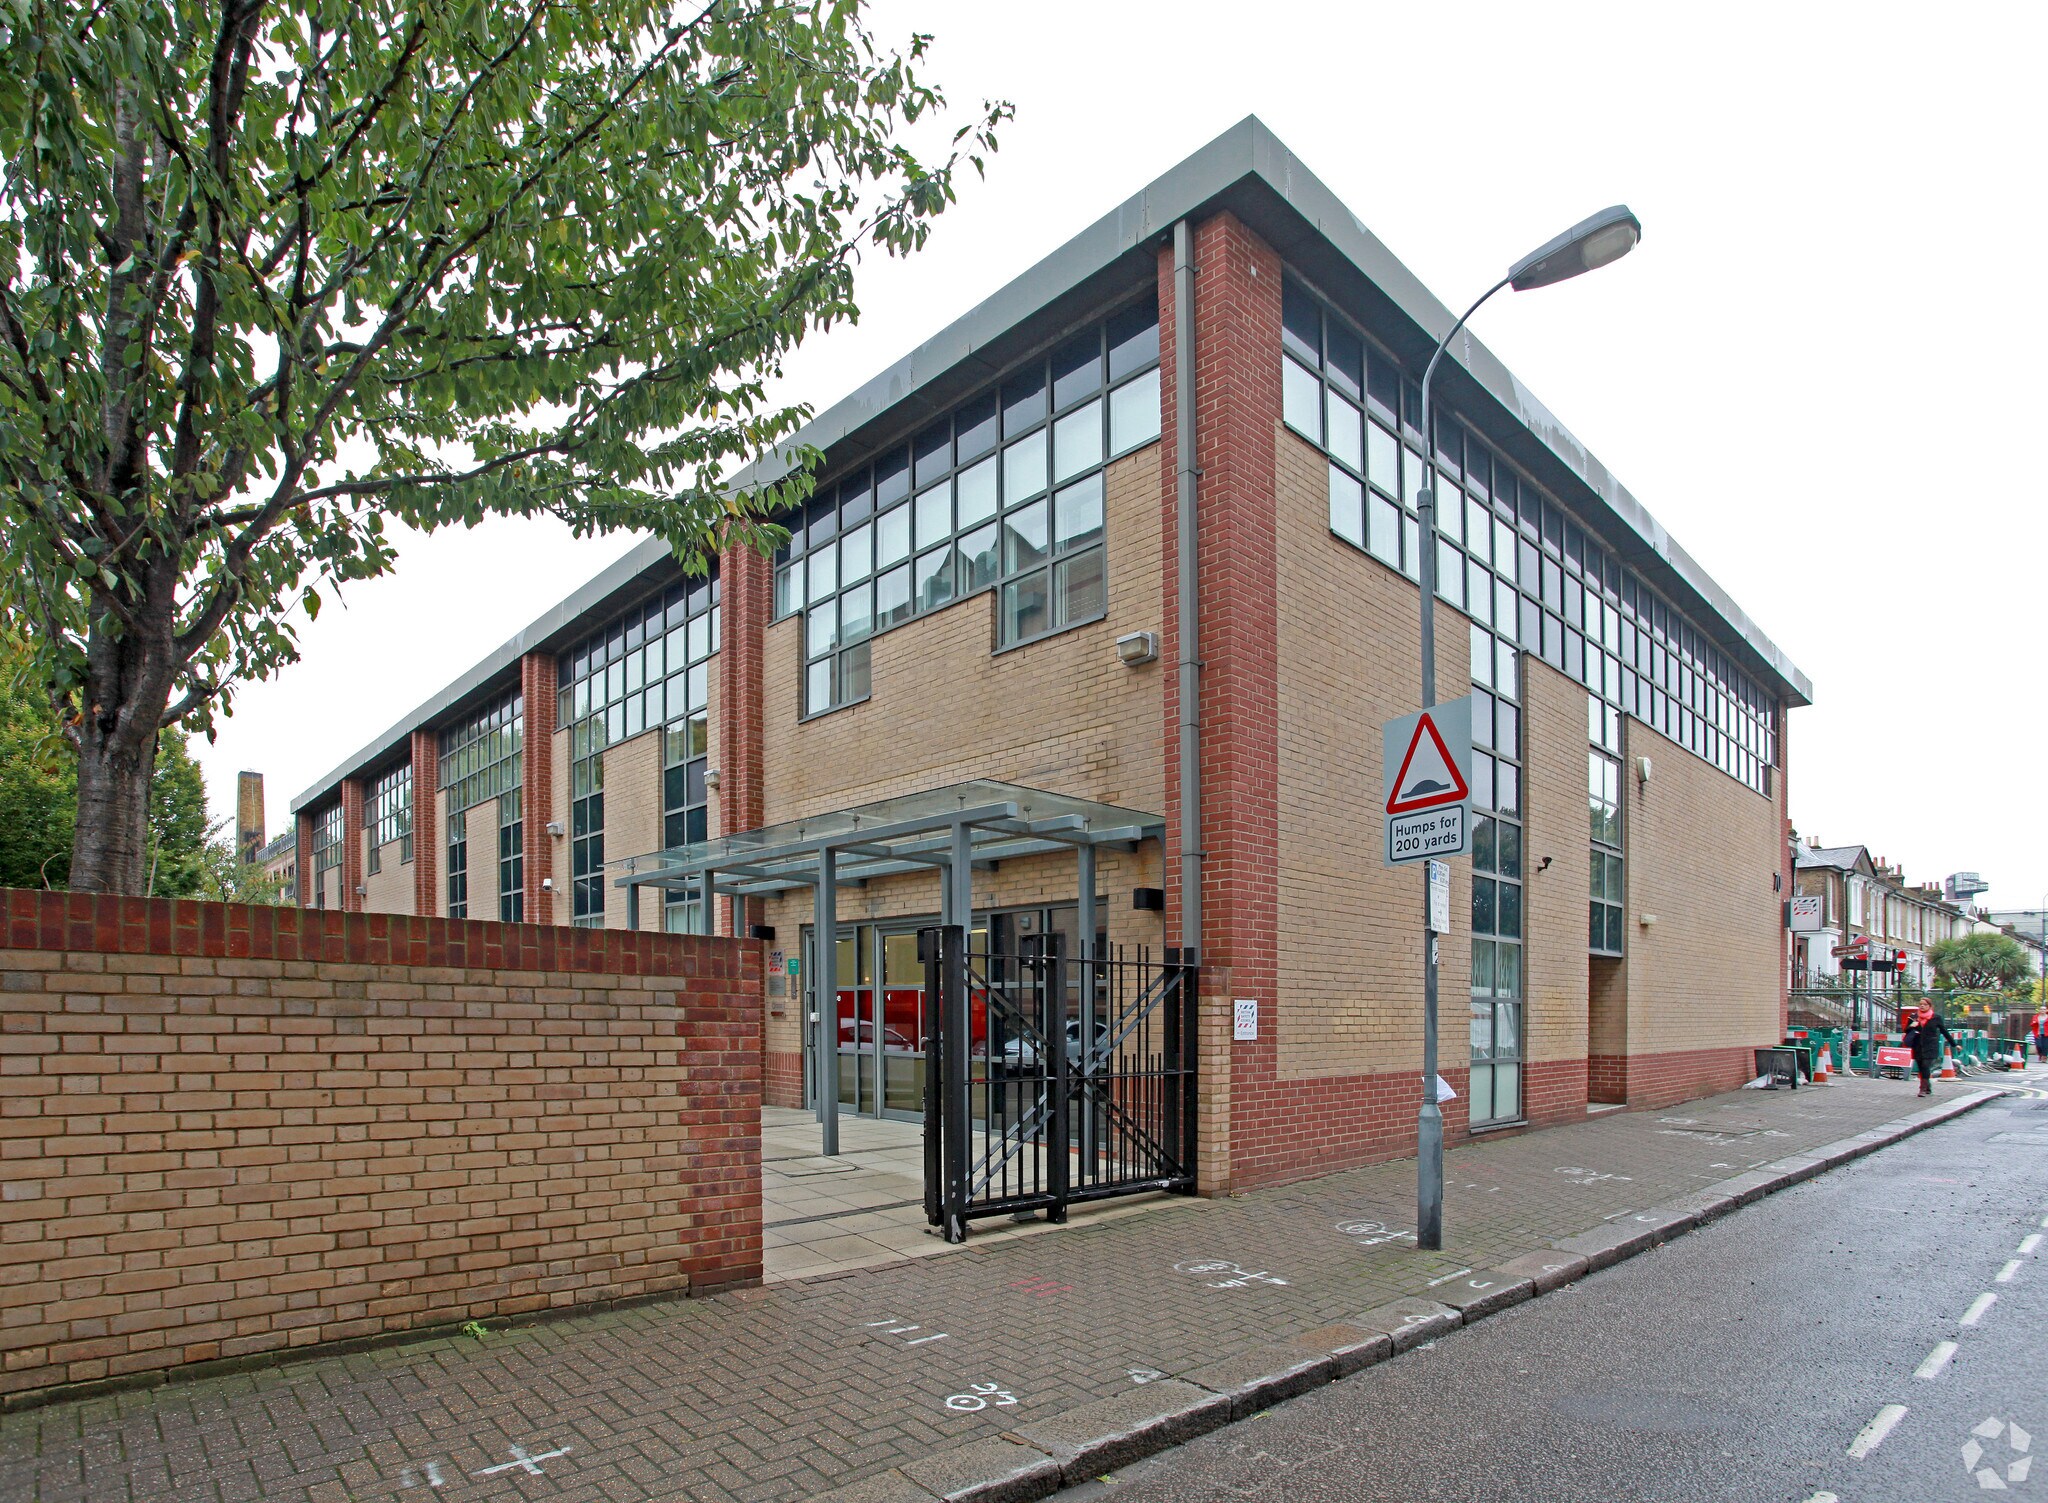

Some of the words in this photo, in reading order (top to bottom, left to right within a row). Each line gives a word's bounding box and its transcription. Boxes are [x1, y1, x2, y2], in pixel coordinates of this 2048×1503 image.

[1396, 821, 1435, 837] Humps
[1440, 816, 1457, 829] for
[1396, 837, 1420, 852] 200
[1424, 832, 1457, 850] yards
